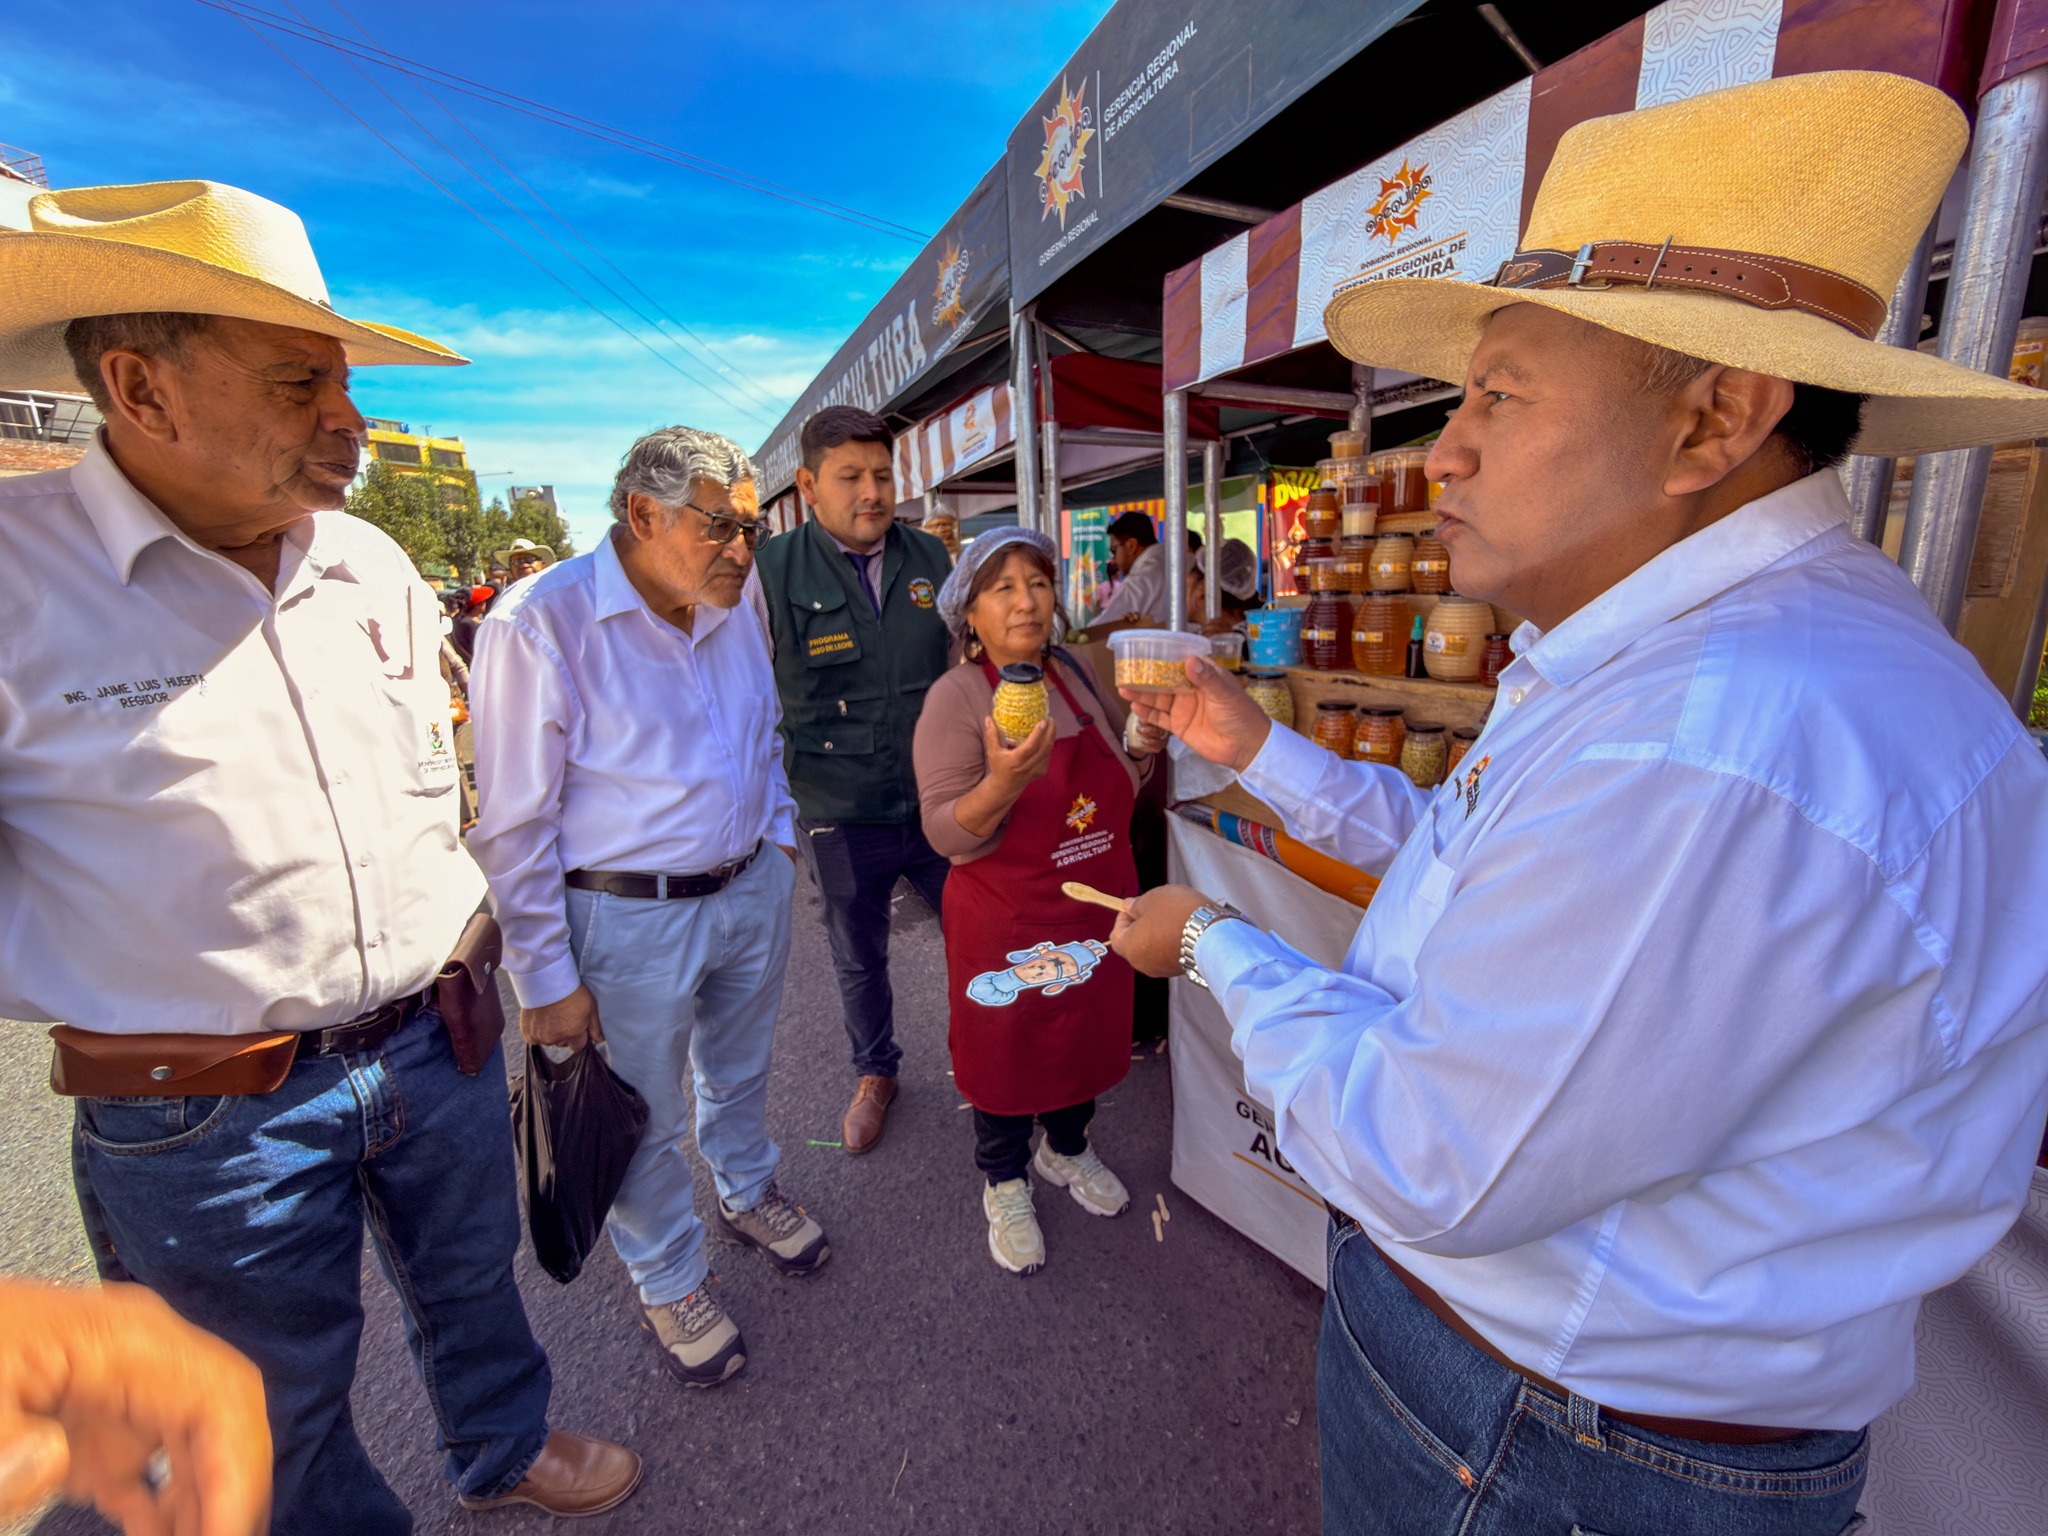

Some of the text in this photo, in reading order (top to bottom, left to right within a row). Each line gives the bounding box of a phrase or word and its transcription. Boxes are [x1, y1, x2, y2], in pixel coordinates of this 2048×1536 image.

[1104, 20, 1198, 123] GERENCIA REGIONAL
[1104, 61, 1179, 142] DE AGRICULTURA
[1039, 210, 1099, 266] GOBIERNO REGIONAL
[1361, 252, 1395, 270] GOBIERNO
[1397, 236, 1433, 255] REGIONAL
[1387, 248, 1446, 279] REGIONAL
[1450, 239, 1467, 255] DE
[808, 632, 849, 648] PROGRAMA
[63, 674, 207, 705] ING. JAIME LUIS HUERTA
[120, 692, 172, 709] REGIDOR
[1056, 842, 1112, 868] AGRICULTURA
